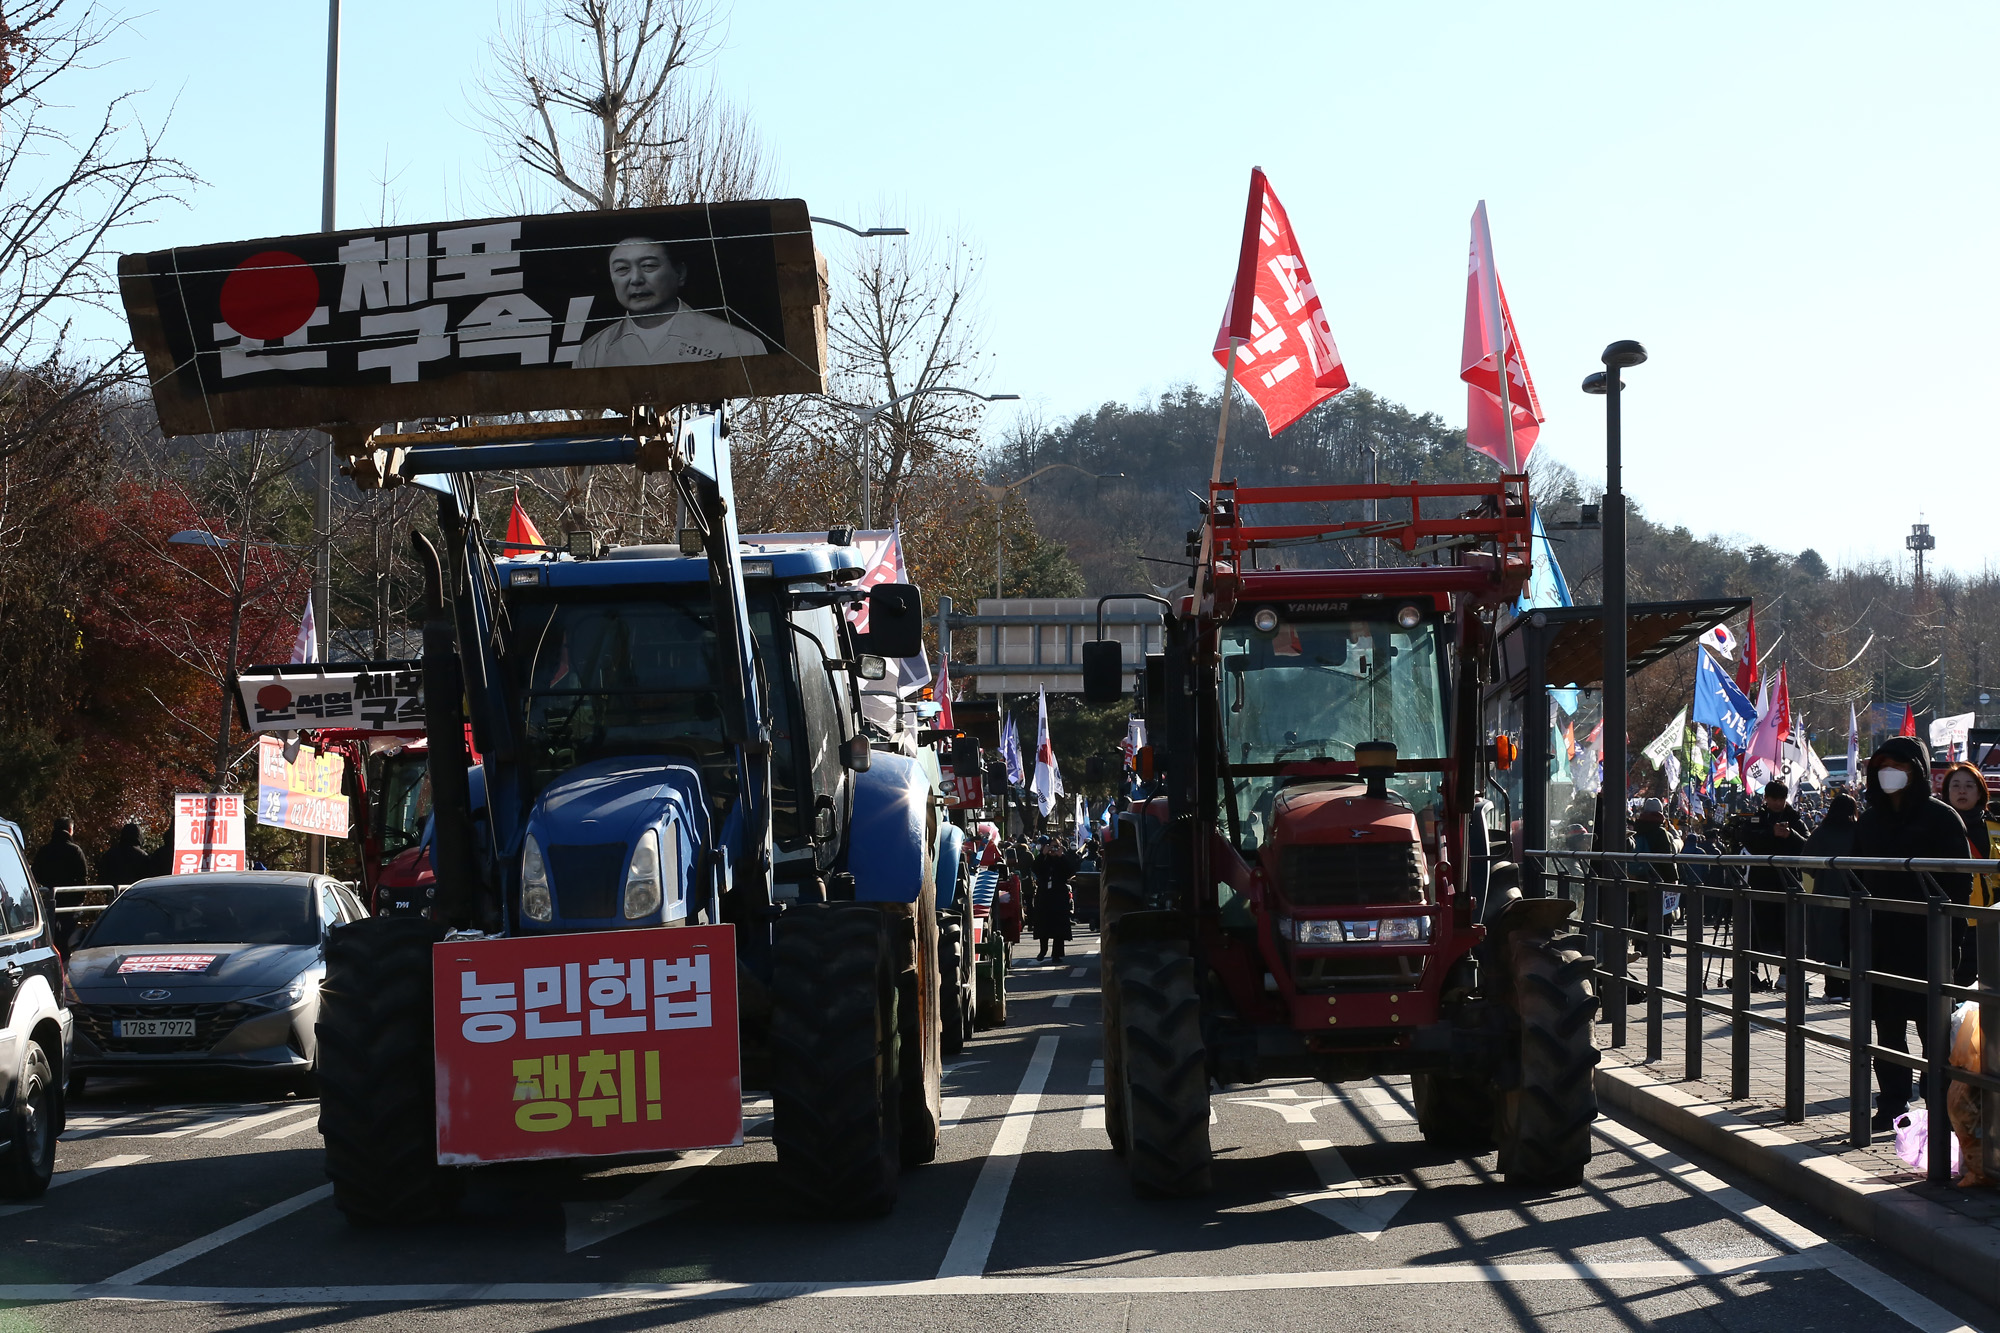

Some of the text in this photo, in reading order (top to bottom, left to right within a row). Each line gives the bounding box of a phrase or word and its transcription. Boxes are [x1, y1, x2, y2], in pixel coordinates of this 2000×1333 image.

[338, 222, 525, 313] 체포
[357, 293, 596, 384] 구속!
[1288, 602, 1349, 613] YANMAR
[180, 797, 238, 817] 국민의힘
[160, 1020, 192, 1035] 7972
[459, 953, 712, 1043] 농민헌법
[512, 1049, 662, 1132] 쟁취!
